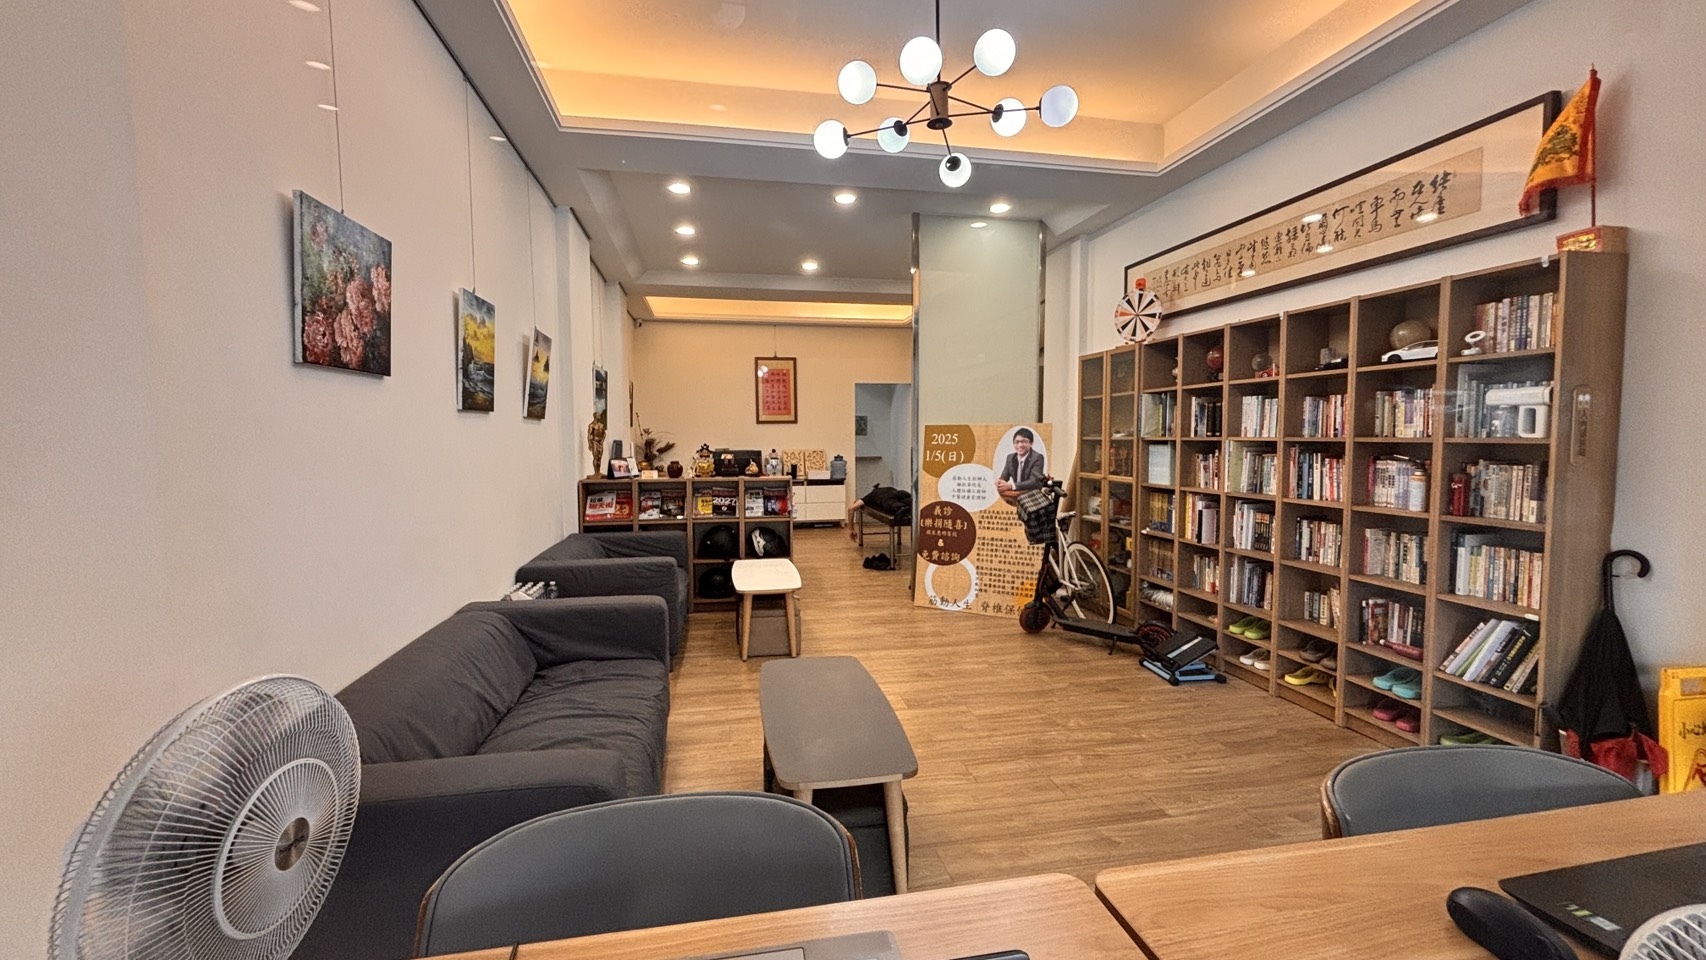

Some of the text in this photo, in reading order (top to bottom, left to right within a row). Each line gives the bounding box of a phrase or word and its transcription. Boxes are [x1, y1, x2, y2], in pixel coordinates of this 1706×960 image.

[931, 433, 959, 445] 2025
[712, 497, 737, 506] 2027
[933, 505, 953, 516] 義診
[937, 538, 944, 547] &
[921, 549, 960, 562] 免費諮詢
[928, 595, 972, 610] 筋動人生
